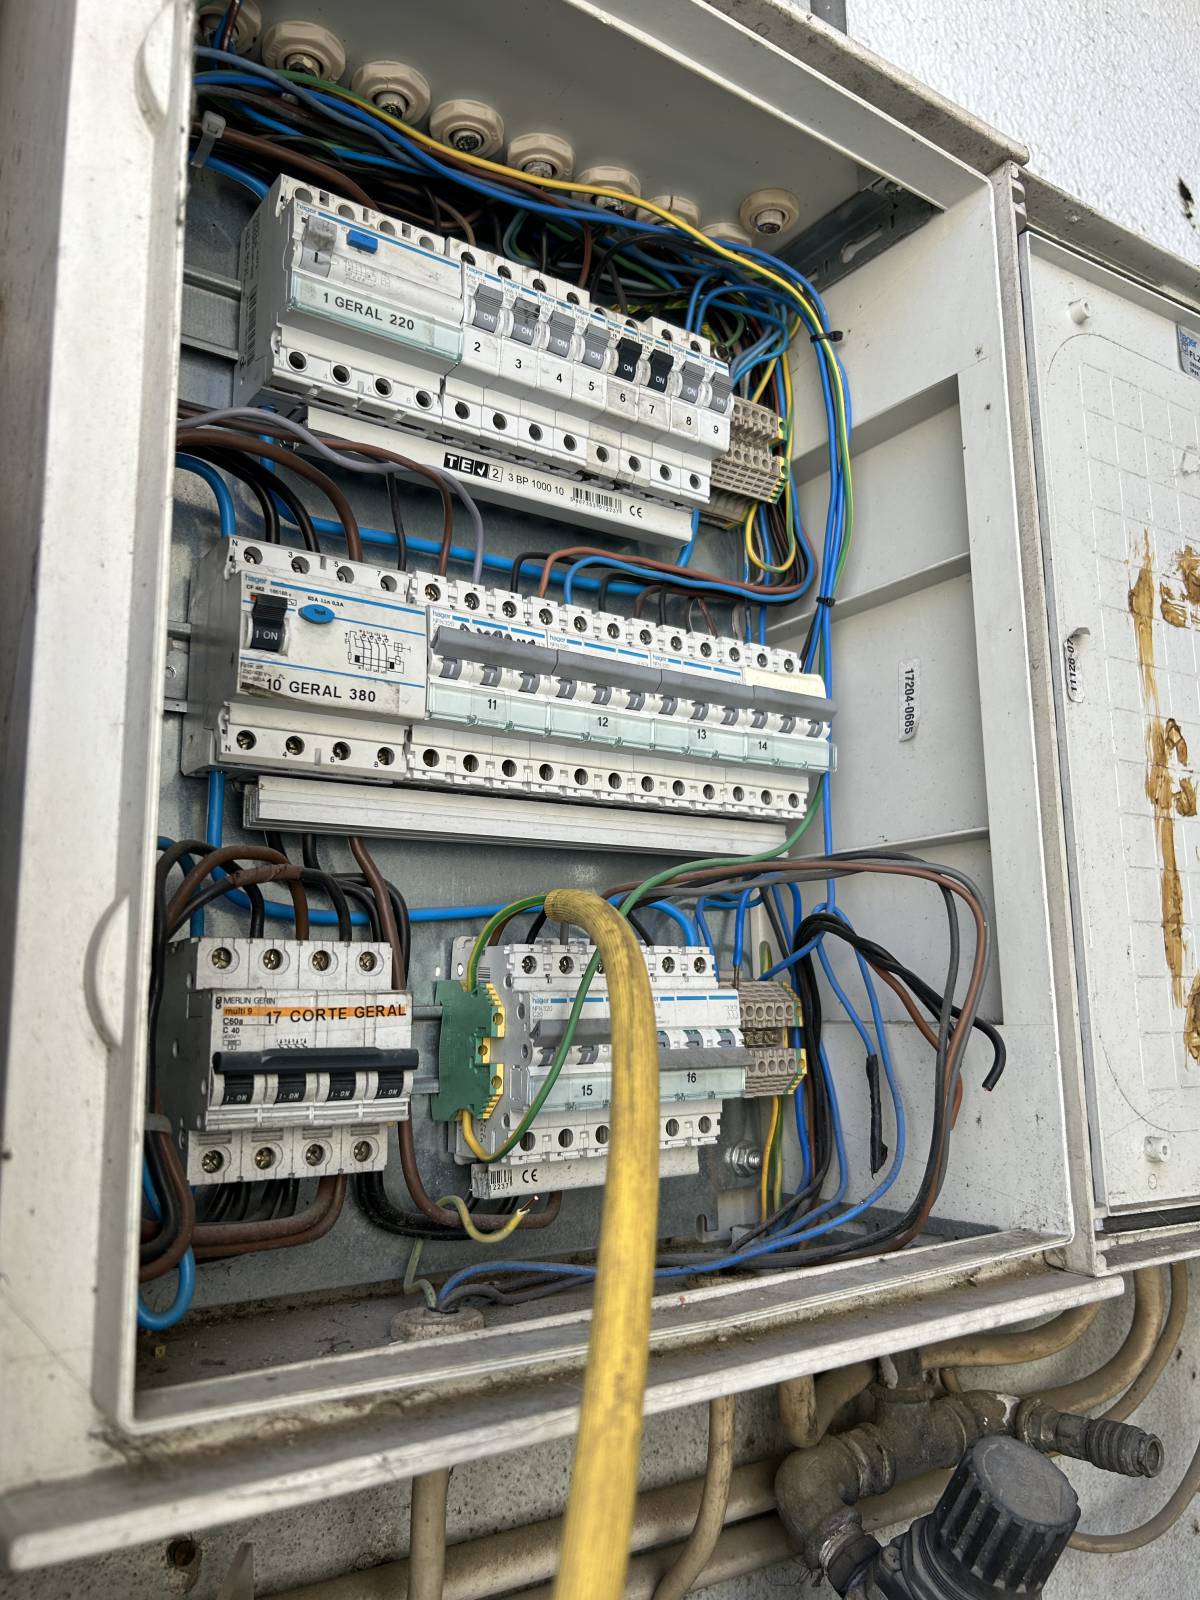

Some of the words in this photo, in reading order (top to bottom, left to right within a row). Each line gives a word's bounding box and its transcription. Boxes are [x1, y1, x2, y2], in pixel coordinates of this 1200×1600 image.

[323, 292, 329, 303] 1
[334, 296, 383, 321] GERAL
[389, 313, 415, 331] 220
[483, 313, 494, 323] ON
[521, 326, 532, 336] ON
[474, 341, 481, 352] 2
[557, 339, 568, 349] ON
[590, 350, 601, 360] ON
[515, 359, 522, 369] 3
[623, 363, 633, 373] ON
[556, 373, 563, 383] 4
[655, 375, 665, 384] ON
[588, 381, 595, 391] 5
[687, 386, 696, 396] ON
[620, 393, 626, 402] 6
[649, 404, 655, 414] 7
[686, 416, 692, 425] 8
[713, 425, 719, 434] 9
[508, 473, 514, 482] 3
[516, 474, 529, 485] BP
[531, 479, 552, 492] 1000
[554, 486, 565, 496] 10
[232, 539, 238, 547] N
[263, 631, 278, 640] ON
[266, 678, 282, 691] 10
[289, 681, 342, 699] GERAL
[349, 688, 376, 703] 380
[487, 698, 497, 710] 11
[904, 667, 915, 735] 17204-0685
[598, 716, 609, 728] 12
[697, 729, 707, 740] 13
[758, 741, 768, 751] 14
[223, 997, 251, 1005] MERLIN
[253, 997, 276, 1005] GERIN
[225, 1007, 246, 1015] multi
[247, 1007, 253, 1015] 9
[265, 1010, 282, 1025] 17
[290, 1006, 347, 1023] CORTE
[353, 1003, 407, 1019] GERAL
[686, 1072, 697, 1083] 16
[581, 1084, 593, 1097] 15
